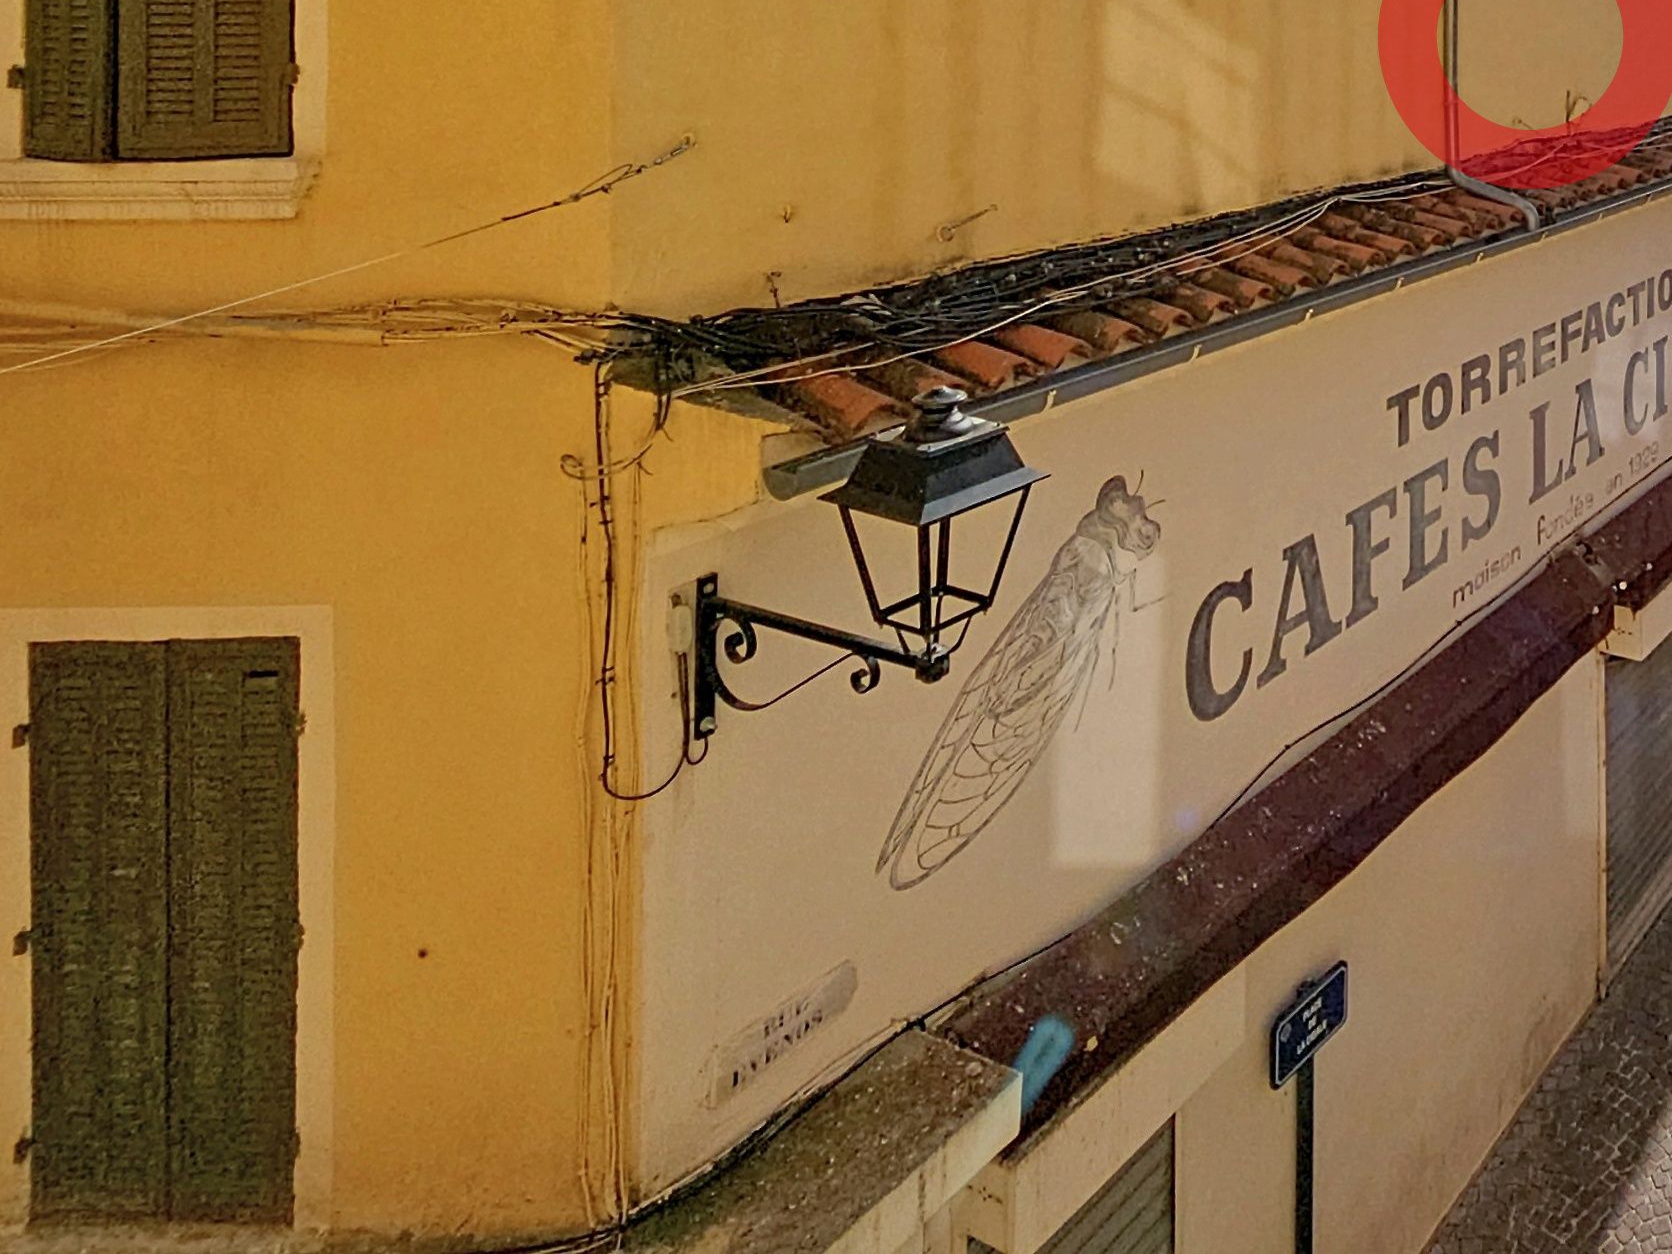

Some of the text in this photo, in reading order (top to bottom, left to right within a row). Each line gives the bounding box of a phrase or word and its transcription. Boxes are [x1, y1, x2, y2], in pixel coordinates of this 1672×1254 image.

[1185, 429, 1500, 722] CAFES
[1528, 377, 1605, 506] LA
[1453, 546, 1521, 608] maison
